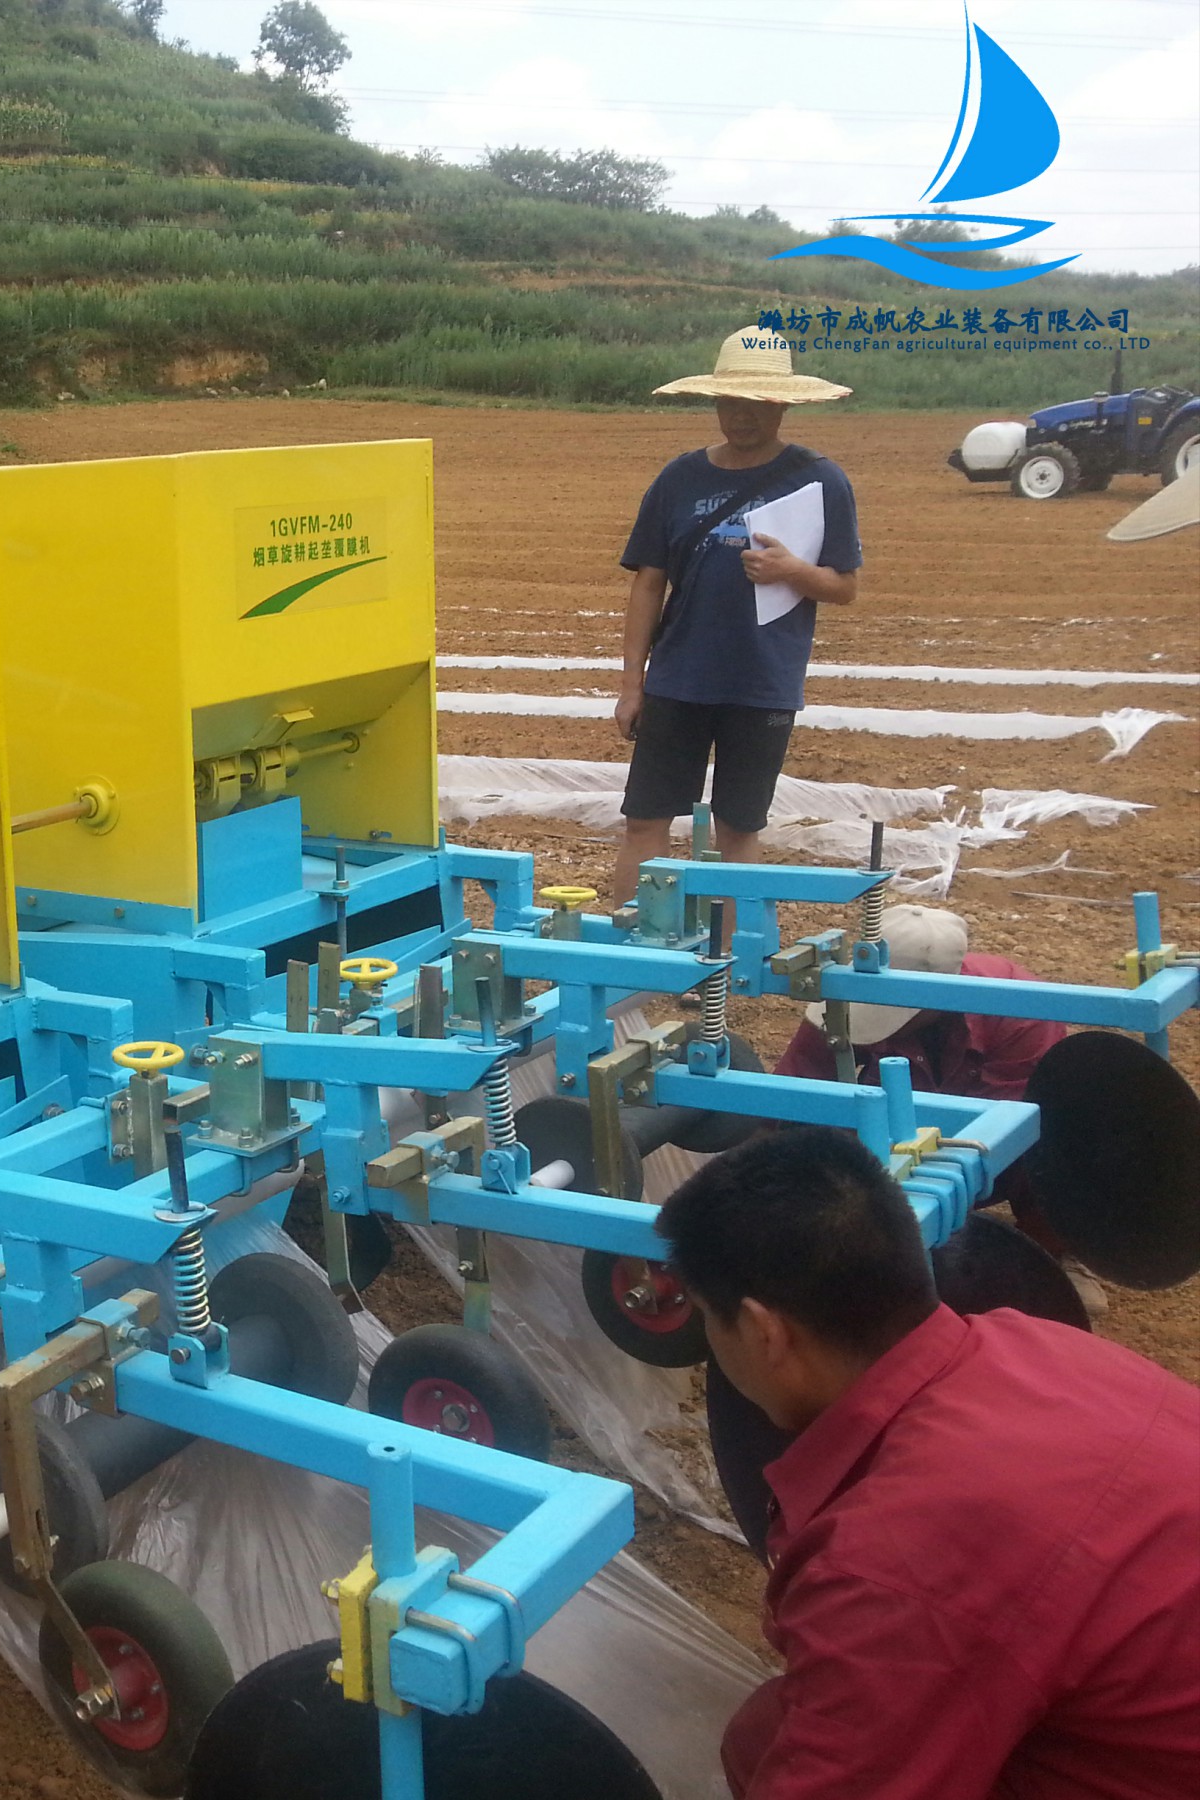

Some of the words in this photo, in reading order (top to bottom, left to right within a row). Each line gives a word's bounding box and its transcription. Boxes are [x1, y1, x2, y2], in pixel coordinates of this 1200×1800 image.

[270, 512, 353, 537] 1GVFM-240
[253, 536, 371, 567] 烟草旋耕起垄覆膜机
